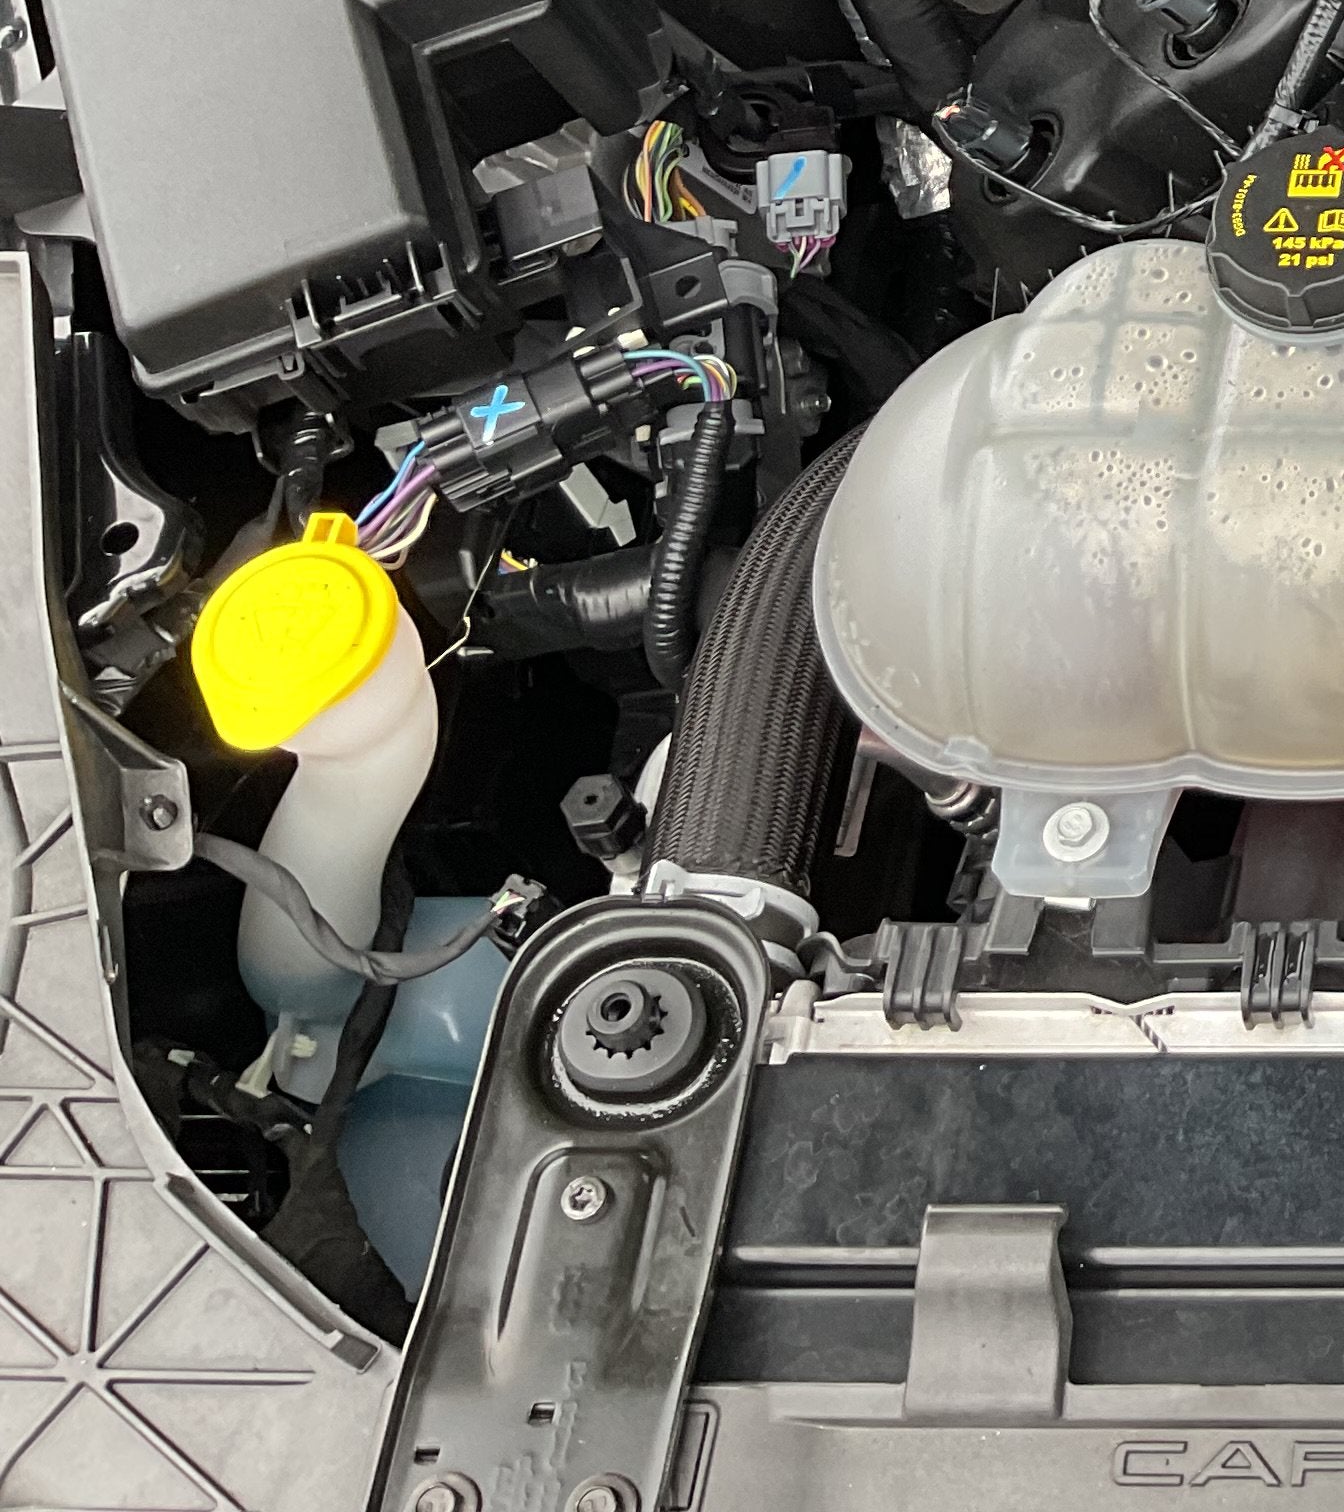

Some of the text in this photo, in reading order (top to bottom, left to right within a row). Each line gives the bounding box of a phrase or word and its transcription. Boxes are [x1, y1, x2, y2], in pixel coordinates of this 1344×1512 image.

[1272, 236, 1344, 250] 145 kPa
[1278, 252, 1335, 269] 21 psi
